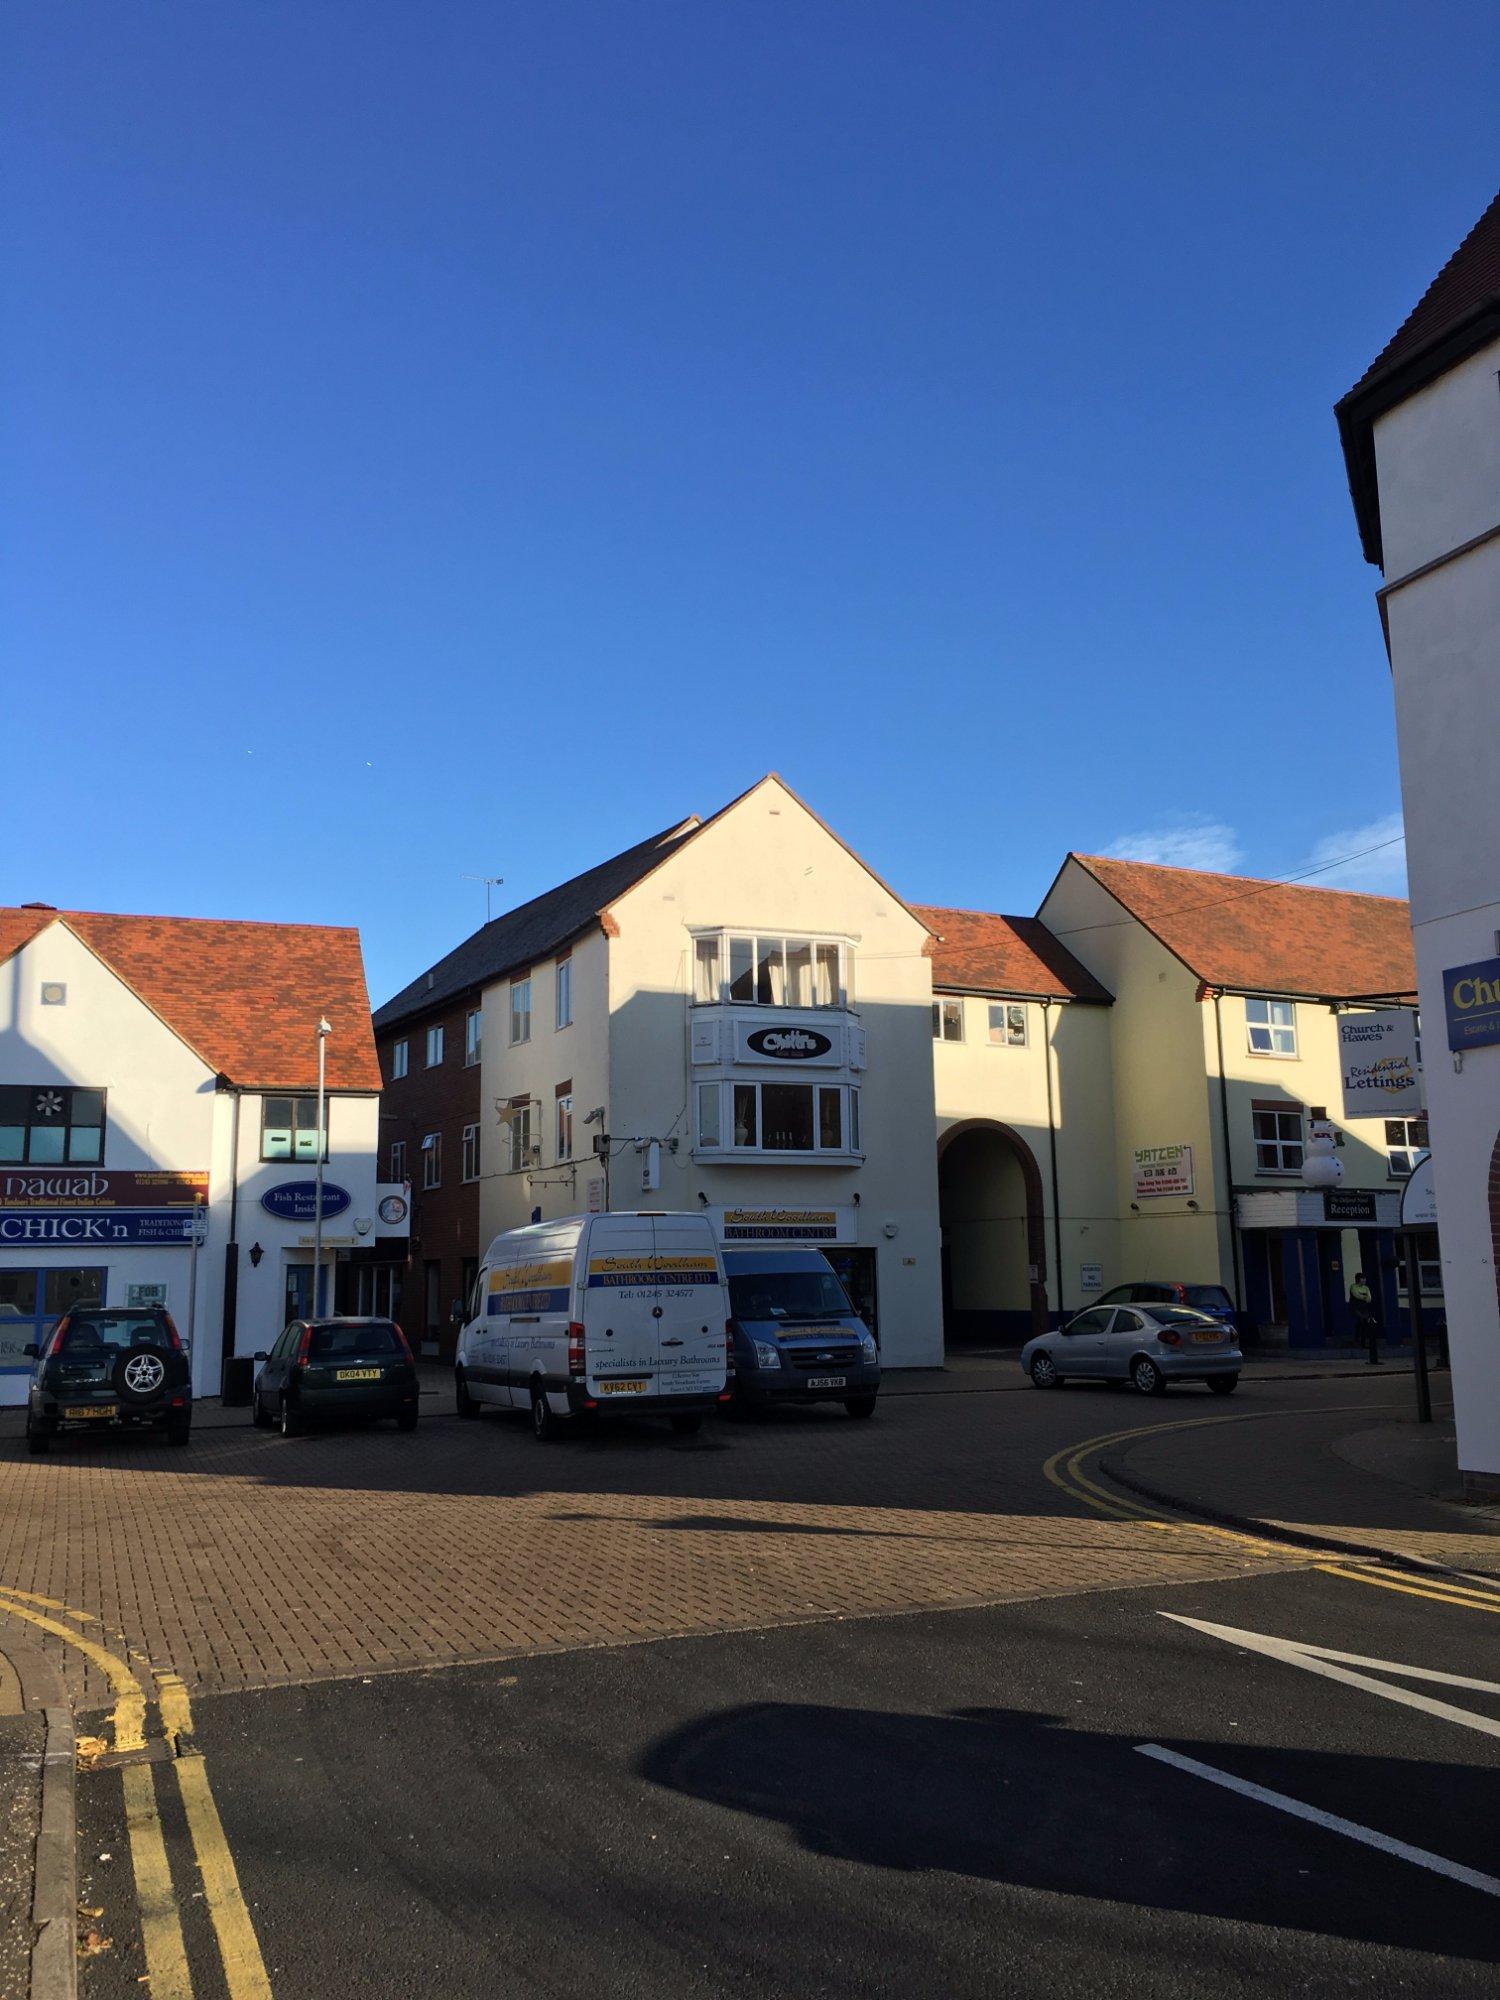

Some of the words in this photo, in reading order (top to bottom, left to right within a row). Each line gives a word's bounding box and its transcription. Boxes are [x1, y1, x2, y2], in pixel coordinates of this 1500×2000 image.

[1341, 1024, 1385, 1034] Church
[1342, 1033, 1382, 1042] Hawes
[1351, 1056, 1409, 1078] Residential
[1344, 1076, 1416, 1090] Lettings
[6, 1172, 109, 1196] nawab
[274, 1192, 292, 1201] Fish
[295, 1203, 319, 1213] Insid
[1330, 1203, 1370, 1216] Reception
[731, 1208, 768, 1224] South
[1, 1217, 129, 1238] CHICK'n
[138, 1228, 157, 1236] FISH
[726, 1227, 790, 1238] BATHROOM
[793, 1227, 836, 1238] CENTRE
[601, 1256, 642, 1272] South
[603, 1275, 655, 1286] BATHROOM
[658, 1273, 692, 1284] CENTRE
[618, 1290, 634, 1299] Tel:
[636, 1289, 663, 1299] 01245
[666, 1288, 694, 1298] 324577
[595, 1357, 637, 1370] specialists
[638, 1357, 647, 1367] in
[648, 1356, 679, 1369] Luxury
[680, 1354, 720, 1366] Bathrooms
